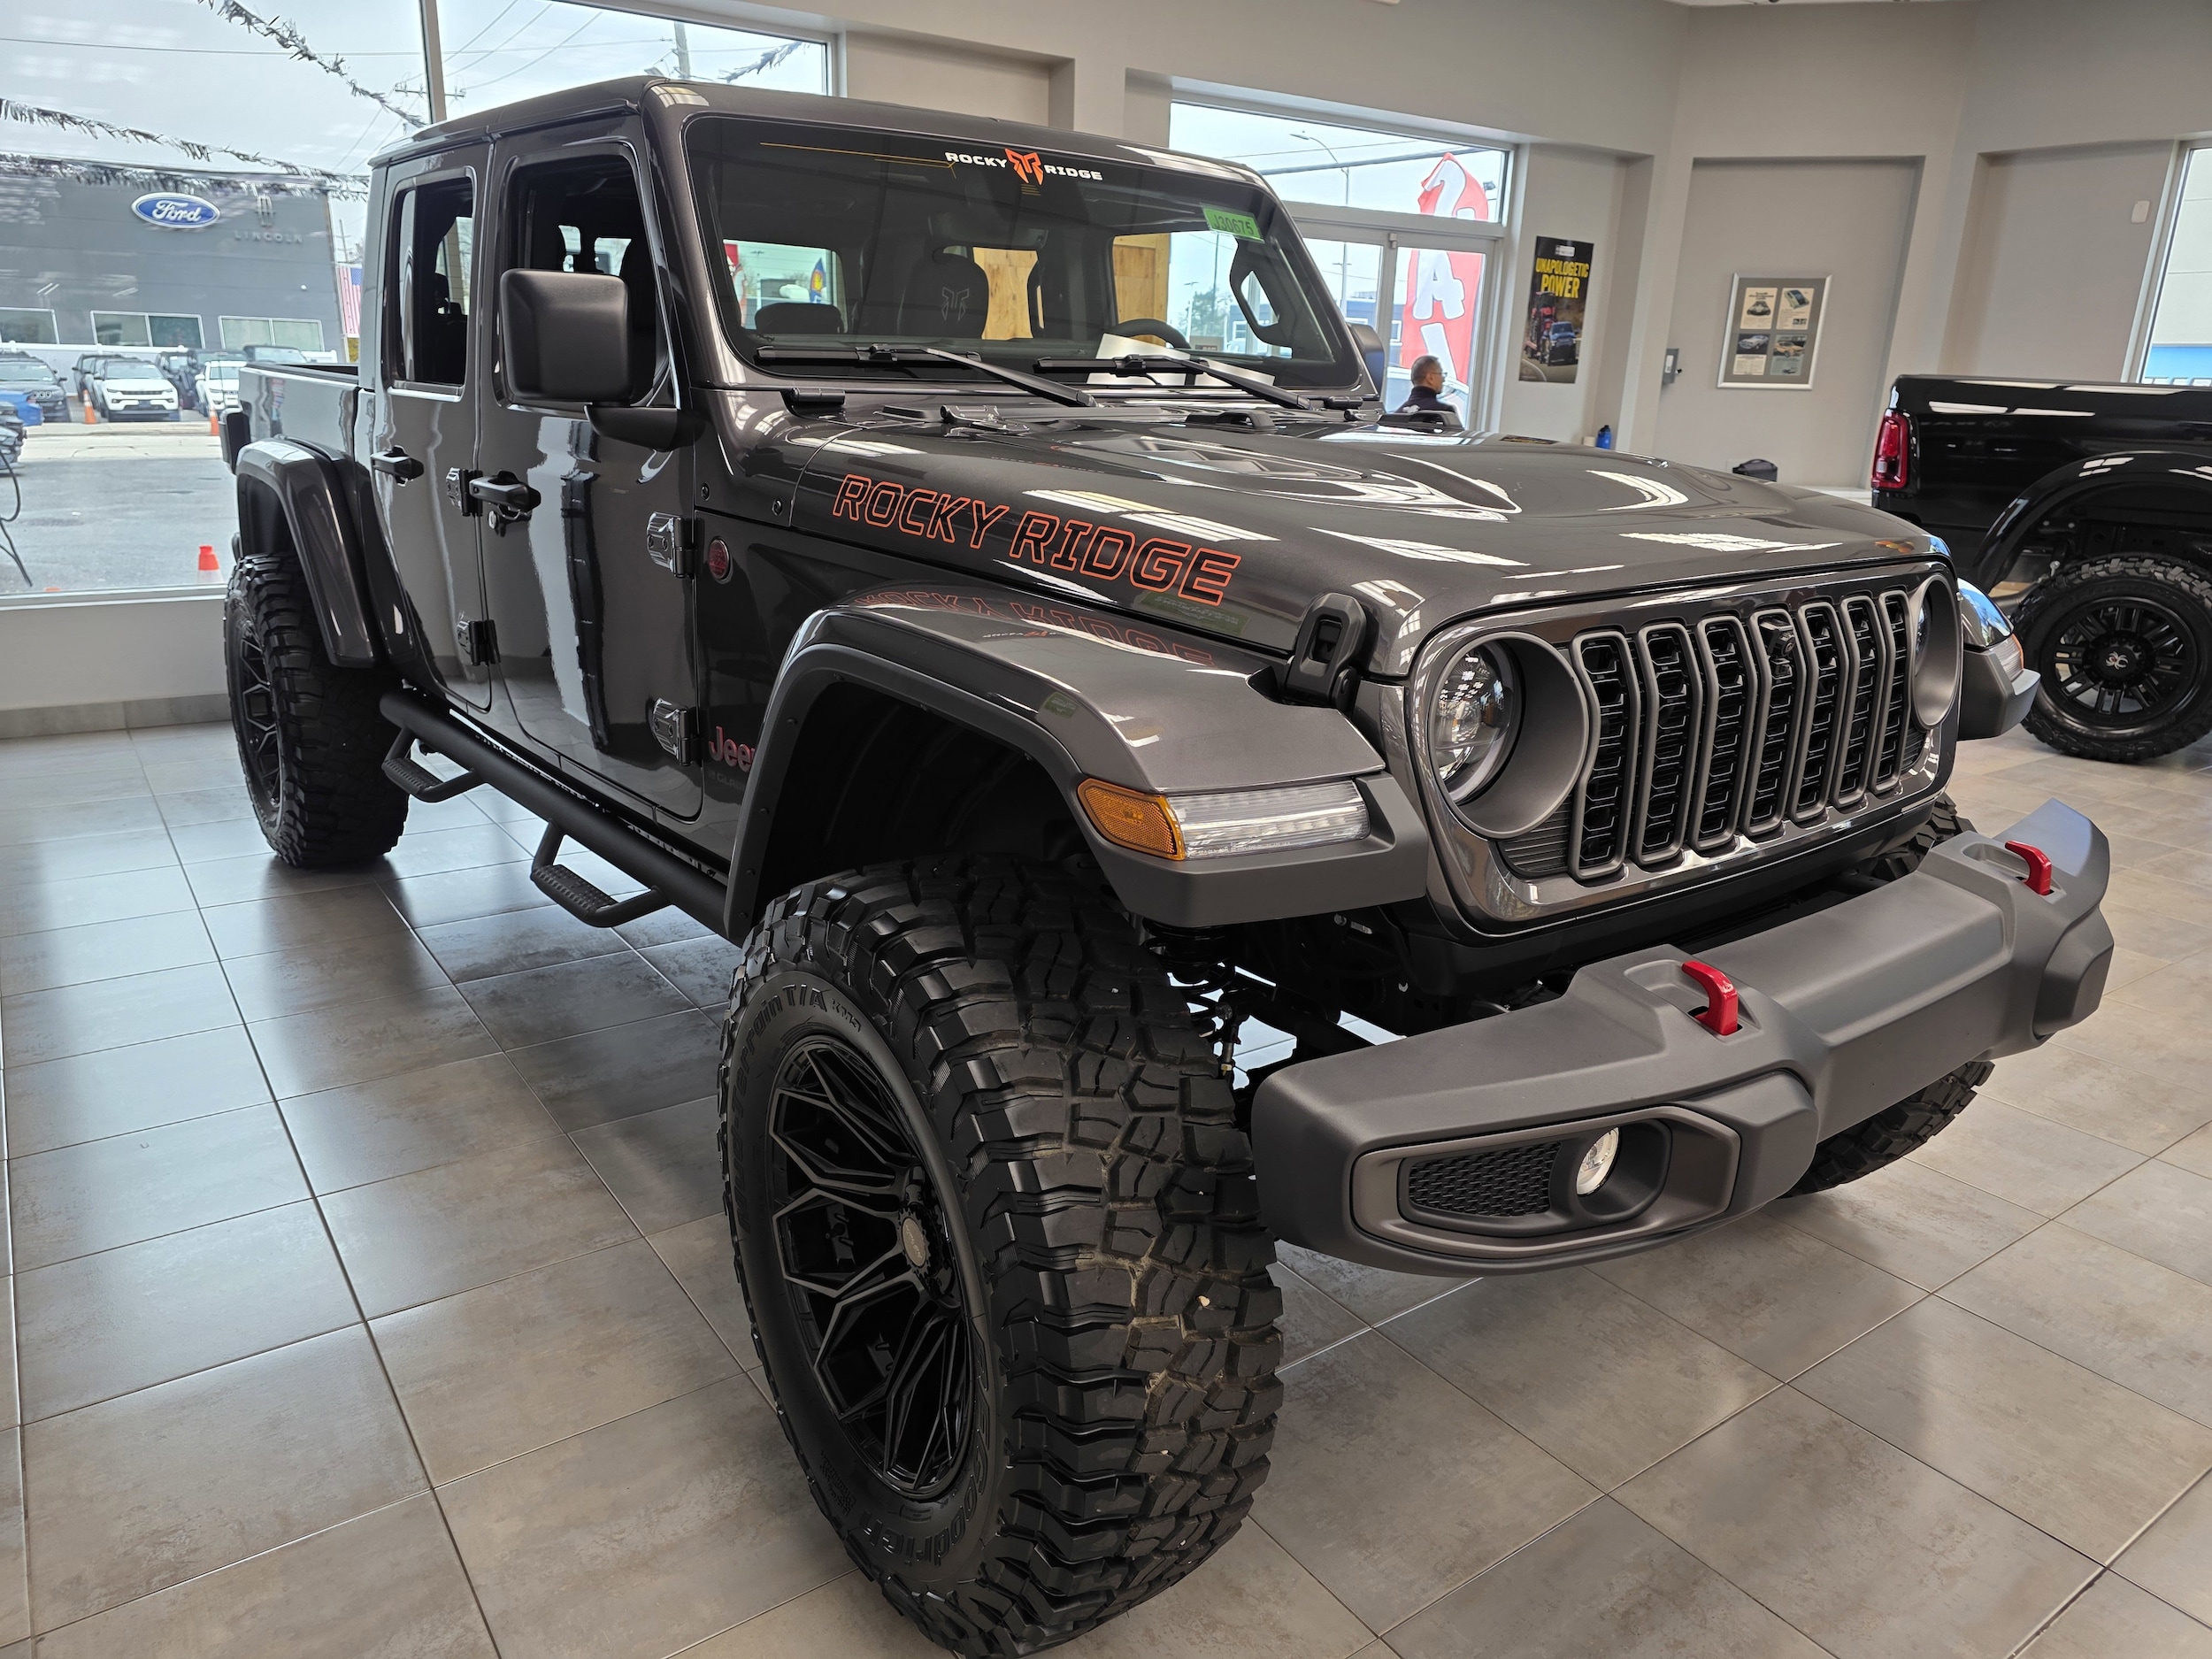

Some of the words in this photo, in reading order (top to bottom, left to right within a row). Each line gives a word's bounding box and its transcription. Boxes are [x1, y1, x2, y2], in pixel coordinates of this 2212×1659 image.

[944, 151, 1008, 168] ROCKY
[1043, 165, 1103, 180] RIDGE
[151, 200, 202, 221] Ford
[1211, 213, 1255, 235] J30675
[234, 230, 303, 243] LINCOLN
[1535, 257, 1590, 279] UNAPOLOGETIC
[1540, 273, 1580, 298] POWER
[832, 474, 1010, 549] ROCKY
[1010, 511, 1241, 606] RIDGE
[782, 983, 827, 1013] T/A
